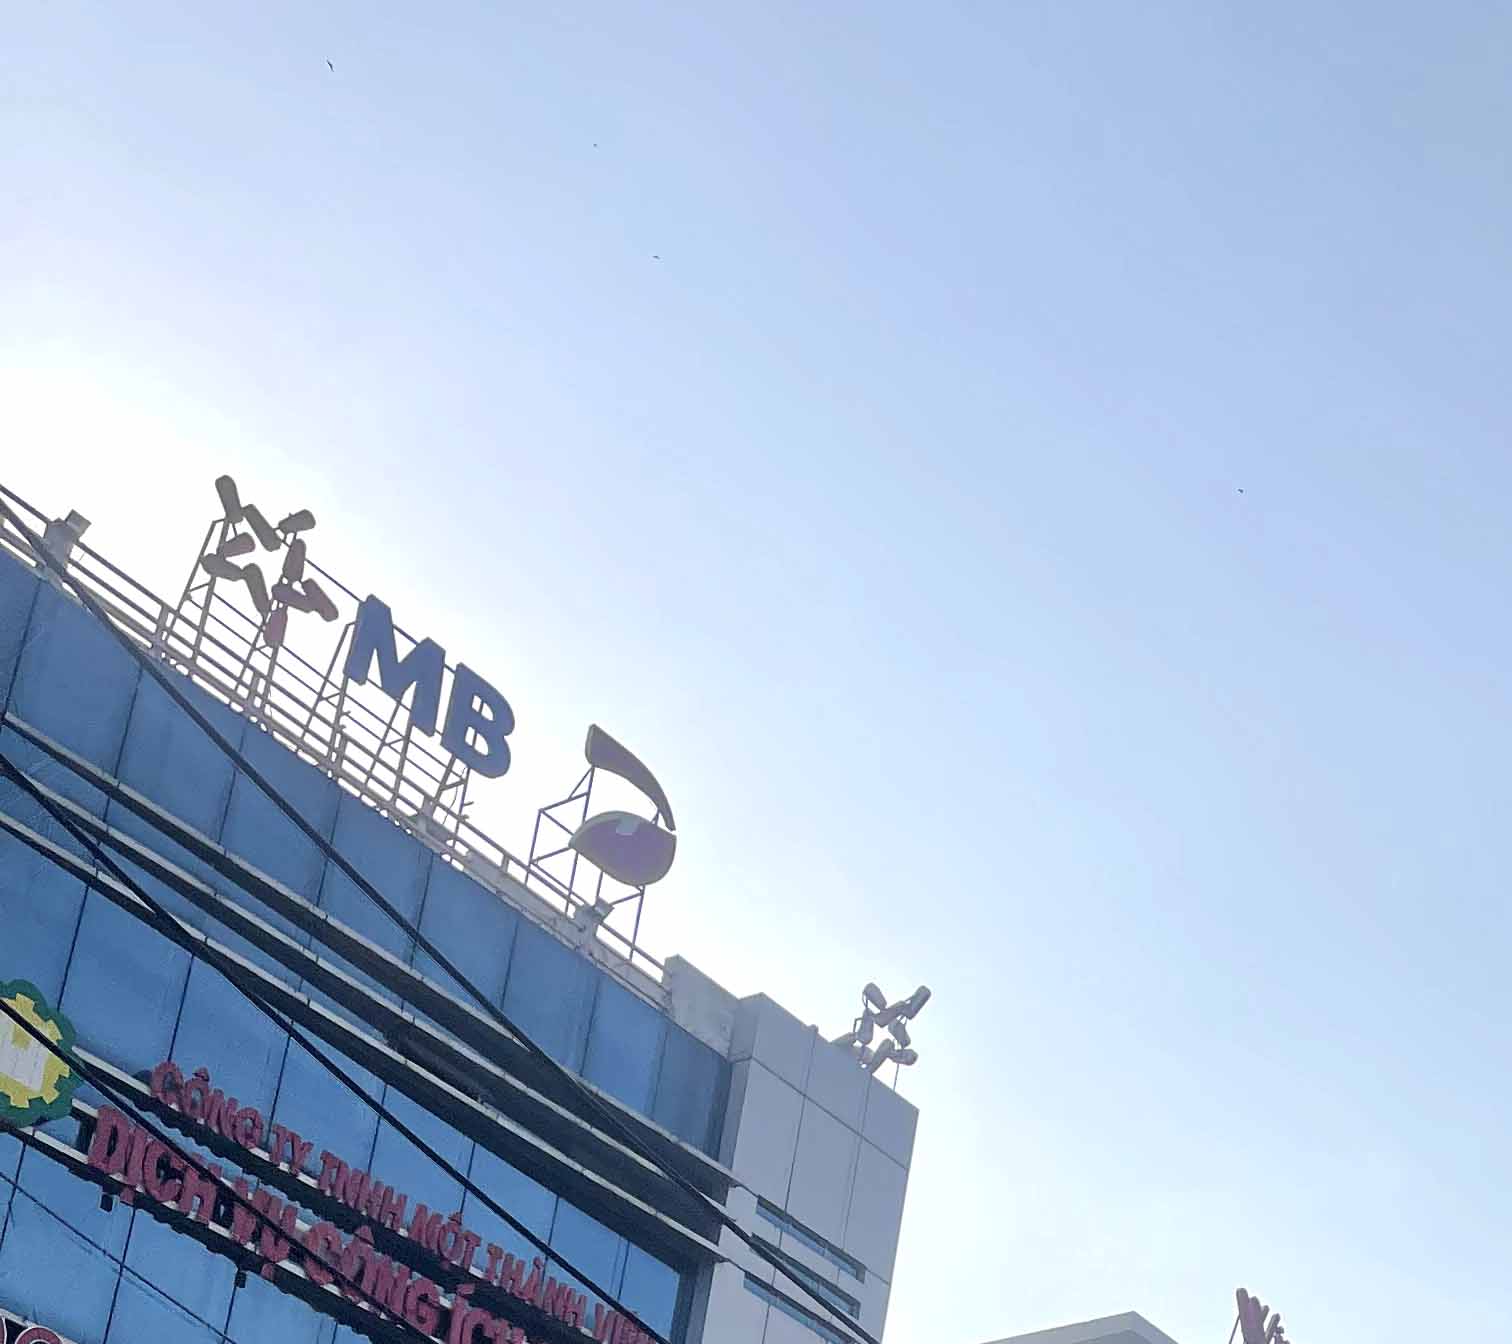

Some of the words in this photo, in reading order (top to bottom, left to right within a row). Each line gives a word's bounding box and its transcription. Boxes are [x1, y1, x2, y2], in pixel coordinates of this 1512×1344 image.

[343, 594, 515, 778] MB
[88, 1104, 222, 1224] DỊCH
[301, 1222, 440, 1336] CÔNG
[151, 1061, 264, 1148] CÔNG
[269, 1123, 313, 1176] TY
[318, 1150, 408, 1230] TNHH
[409, 1203, 481, 1271] MỘT
[485, 1243, 588, 1329] THÀNH
